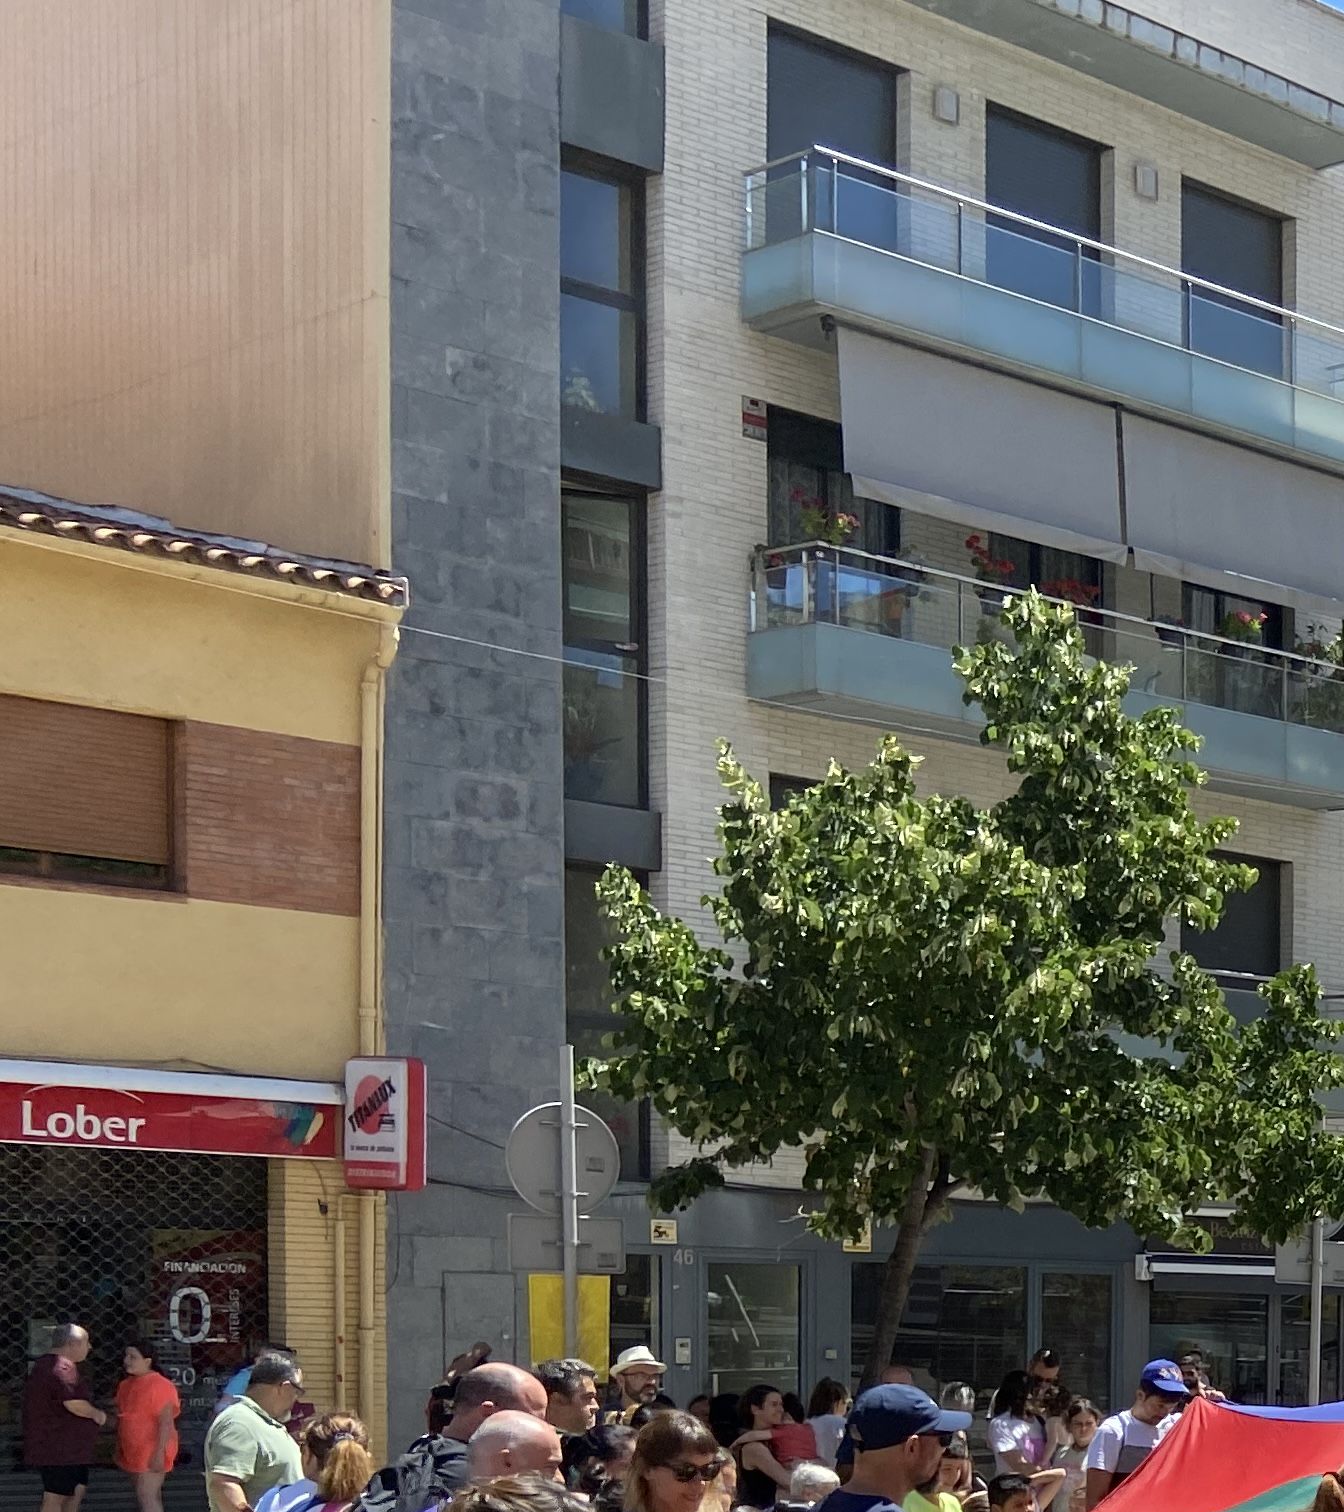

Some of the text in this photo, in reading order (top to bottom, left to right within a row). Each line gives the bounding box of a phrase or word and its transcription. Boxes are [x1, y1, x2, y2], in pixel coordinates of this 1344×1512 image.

[21, 1100, 146, 1143] Lober
[347, 1075, 397, 1133] TITANLUX
[672, 1249, 694, 1265] 46
